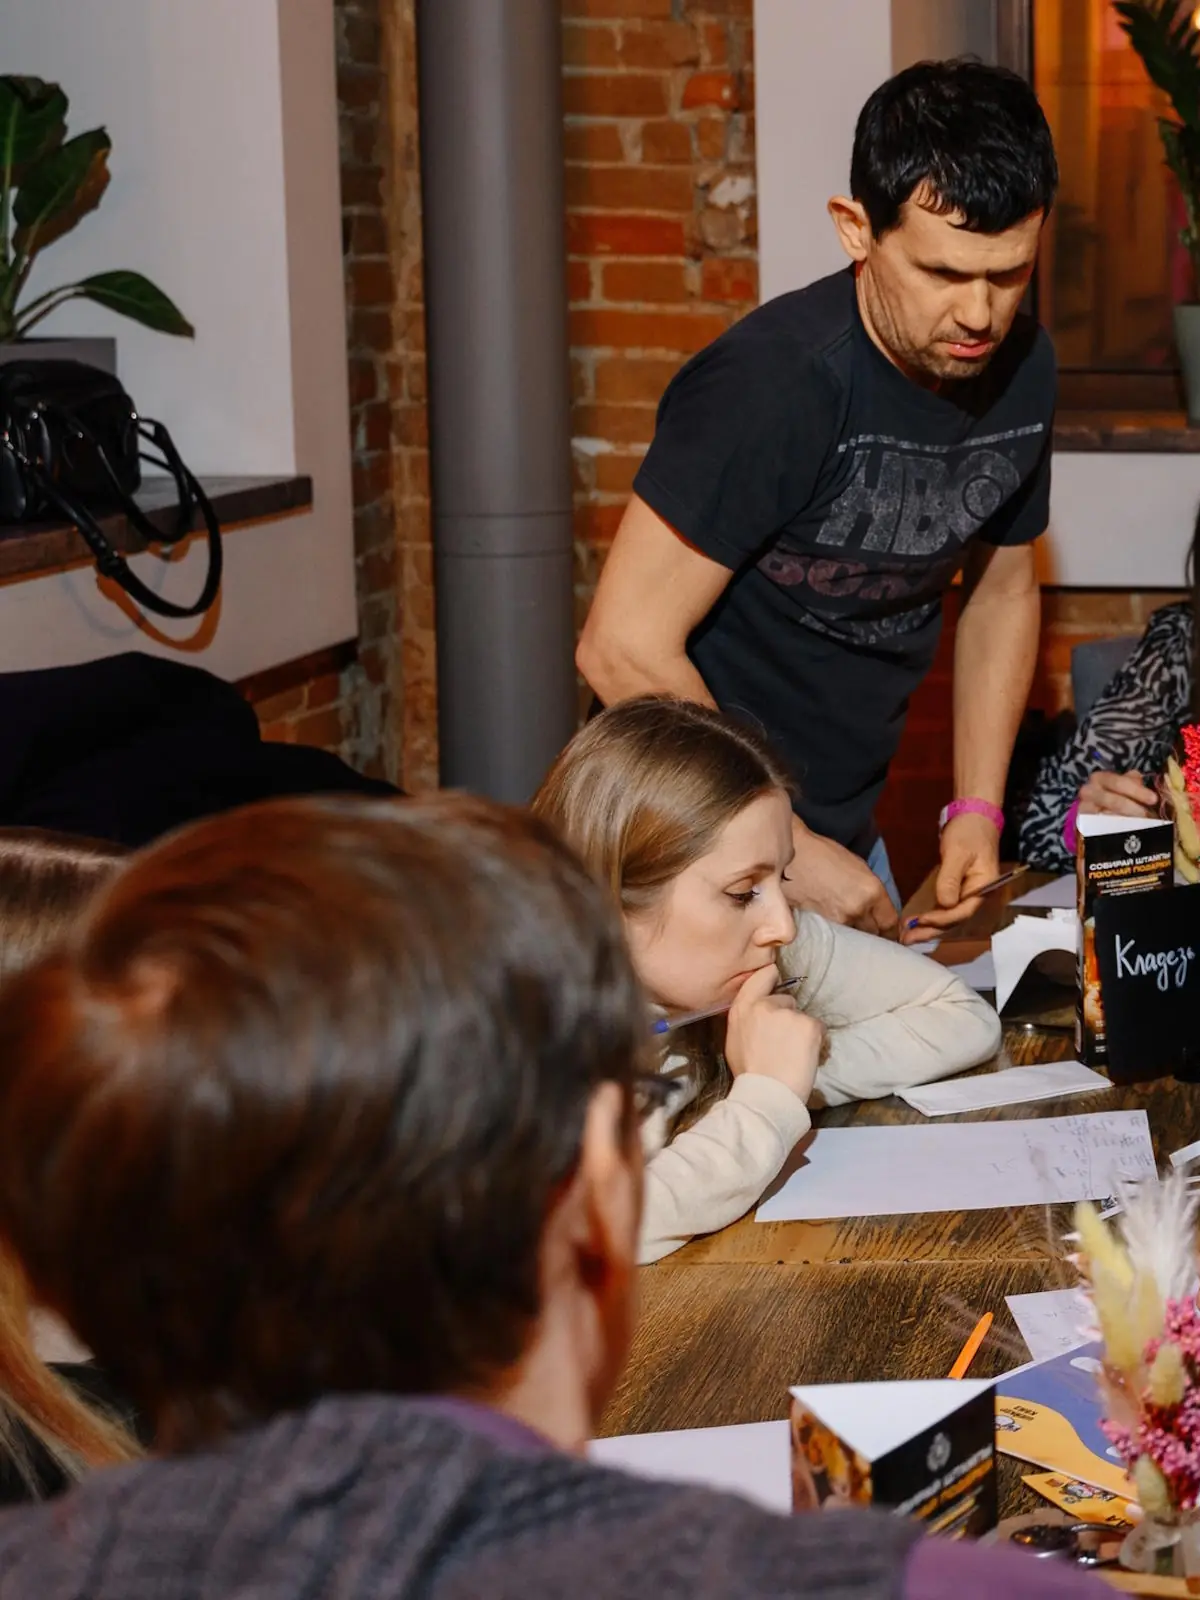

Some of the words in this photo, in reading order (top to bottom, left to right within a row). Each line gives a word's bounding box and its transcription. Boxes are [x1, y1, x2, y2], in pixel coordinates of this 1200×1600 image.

[815, 449, 1021, 556] HBO
[1088, 867, 1132, 879] ПОЛУЧАЙ
[1089, 858, 1134, 871] СОБИРАЙ
[1135, 852, 1171, 865] ШТАМПЫ
[1115, 934, 1195, 992] Кладезь
